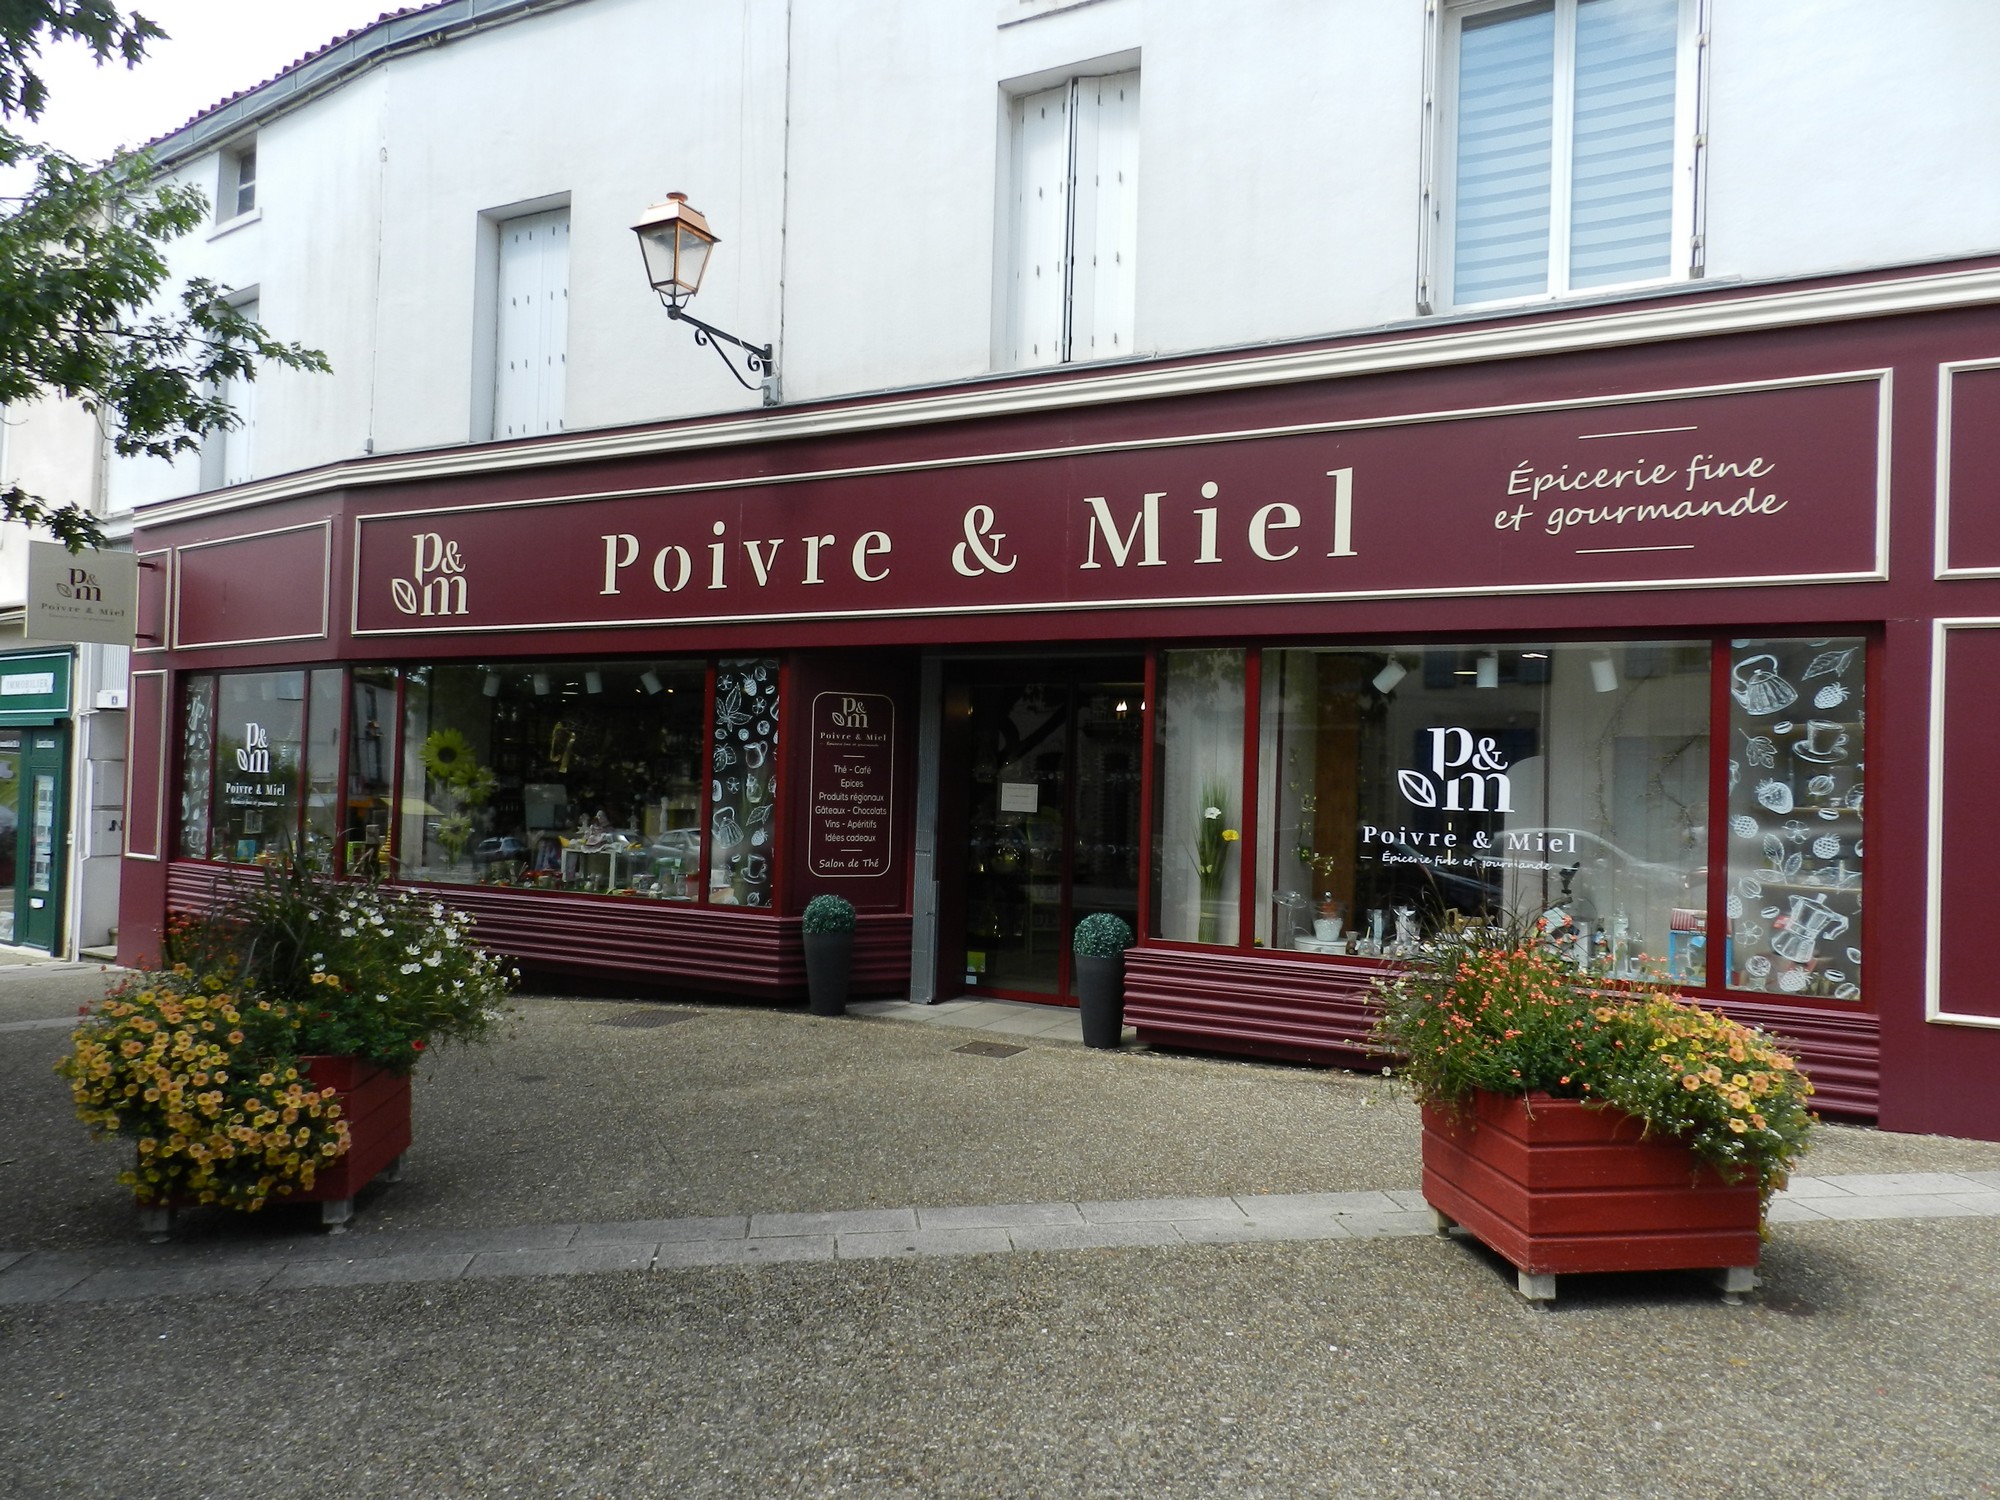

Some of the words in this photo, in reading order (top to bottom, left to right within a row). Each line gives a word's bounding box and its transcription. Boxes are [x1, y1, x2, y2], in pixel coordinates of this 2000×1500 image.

[1507, 460, 1678, 500] Épicerie
[1685, 454, 1776, 491] fine
[1494, 504, 1534, 532] et
[1545, 487, 1789, 535] gourmande
[599, 521, 892, 596] Poivre
[951, 504, 1017, 577] &
[1080, 466, 1358, 570] Miel
[41, 603, 81, 613] Poivre
[100, 608, 125, 617] Miel
[820, 732, 851, 740] Poivre
[834, 765, 847, 774] Thé
[854, 765, 872, 775] Café
[225, 782, 253, 794] Poivre
[256, 784, 262, 795] &
[266, 784, 286, 796] Miel
[841, 779, 864, 789] Epices
[819, 792, 848, 801] Produits
[850, 793, 884, 804] régionaux
[815, 805, 845, 815] Gâteaux
[852, 806, 887, 815] Chocolats
[825, 820, 840, 828] Vins
[847, 820, 877, 830] Apéritifs
[825, 833, 845, 842] Idées
[846, 834, 876, 842] cadeaux
[1362, 825, 1457, 848] Poivre
[1472, 830, 1492, 849] &
[1508, 832, 1576, 853] Miel
[819, 859, 845, 868] Salon
[848, 858, 859, 868] de
[863, 858, 879, 868] Thé
[1382, 850, 1432, 864] Épicerie
[1434, 855, 1460, 867] fine
[1463, 858, 1476, 867] et
